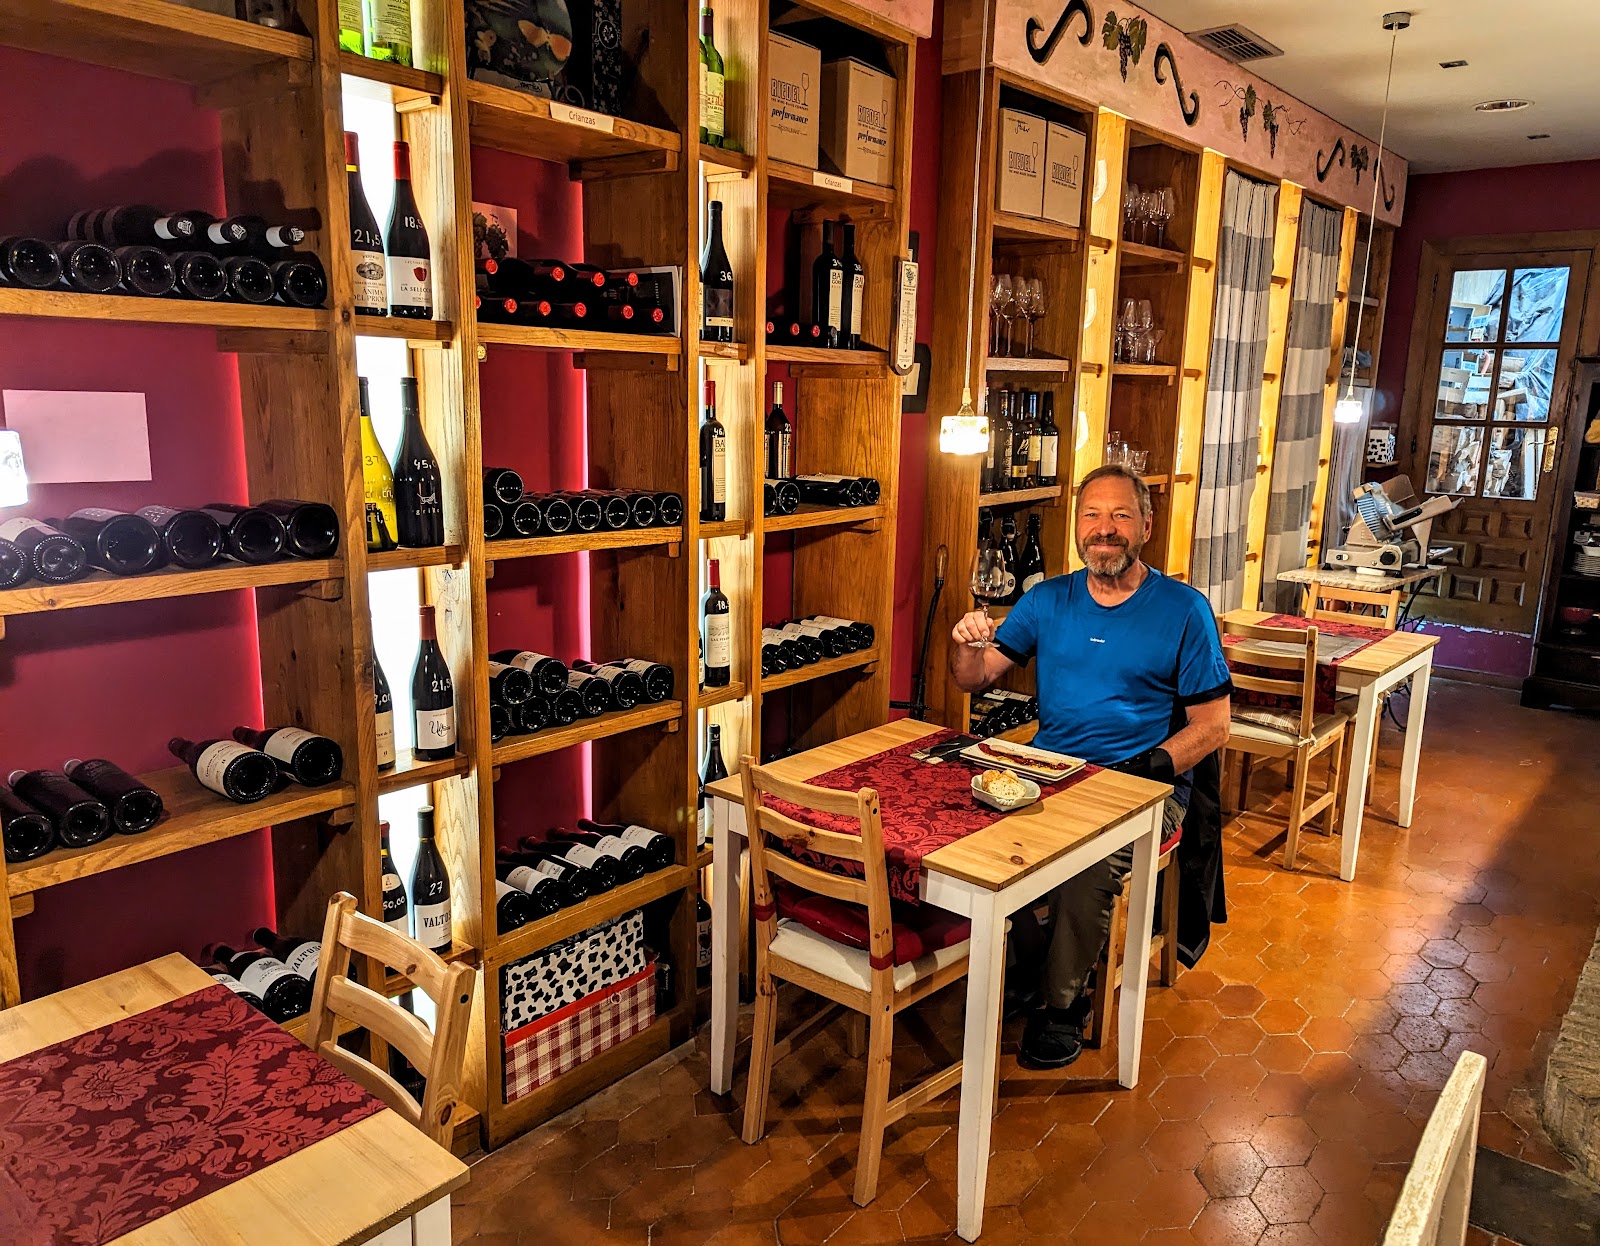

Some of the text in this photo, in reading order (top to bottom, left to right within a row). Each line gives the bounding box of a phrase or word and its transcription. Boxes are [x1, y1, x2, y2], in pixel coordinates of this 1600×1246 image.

[771, 78, 801, 105] RIEDEL
[568, 110, 596, 125] Crianzas
[771, 106, 809, 125] performance
[857, 104, 880, 129] RIEDEL
[857, 130, 887, 147] performance
[1008, 150, 1031, 173] RIEDEL
[1051, 161, 1072, 184] RIEDEL
[824, 177, 842, 189] Crianzas
[354, 229, 384, 247] 21,5
[429, 880, 443, 897] 27
